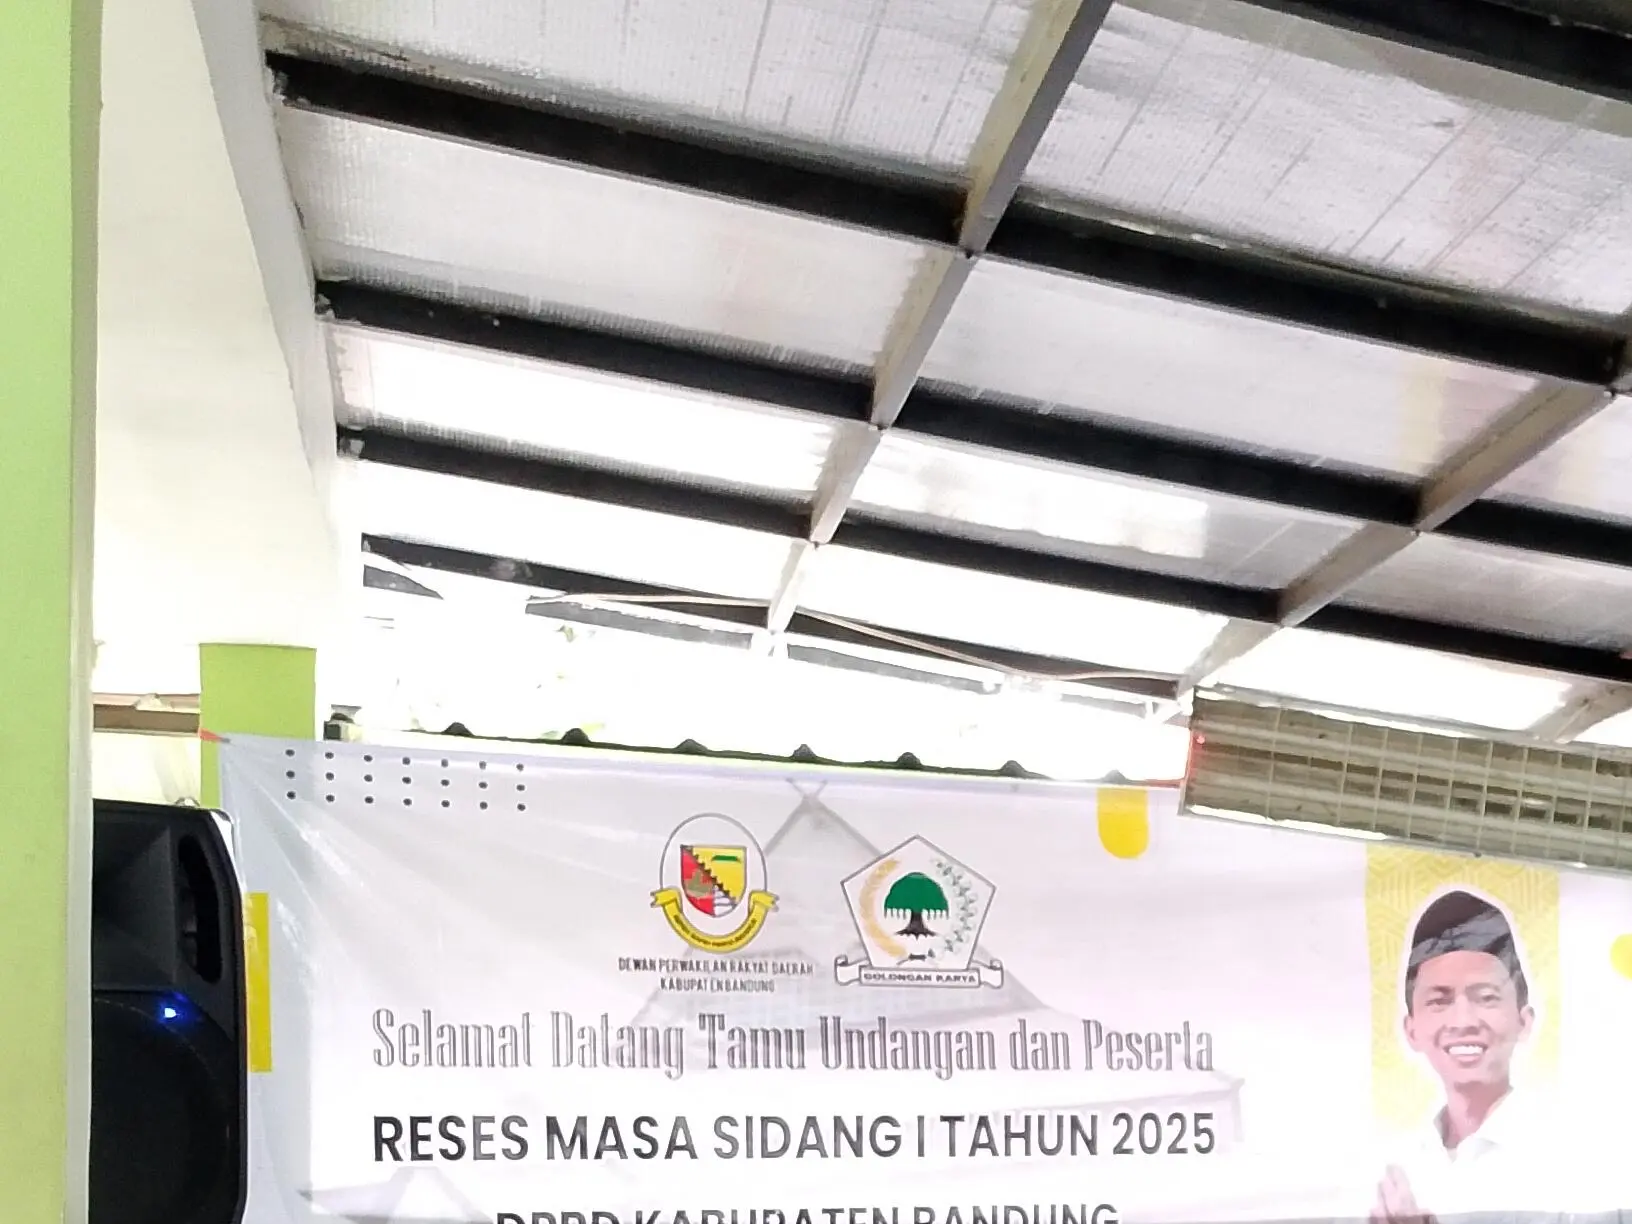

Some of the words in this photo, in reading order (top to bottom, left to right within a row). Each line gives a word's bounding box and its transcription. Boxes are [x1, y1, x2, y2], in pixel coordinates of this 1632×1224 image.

[618, 957, 656, 972] DEWAN
[658, 958, 728, 974] PERWAKILAN
[729, 959, 768, 974] RAKYAT
[772, 961, 814, 976] DAERAH
[660, 977, 724, 992] KABUPATEN
[725, 978, 775, 992] BANDUNG
[863, 973, 932, 982] GOLONGAN
[936, 975, 976, 983] KARYA
[373, 1008, 531, 1068] Selamat
[551, 1011, 686, 1081] Datang
[698, 1012, 806, 1070] Tamu
[819, 1015, 997, 1081] Undangan
[1009, 1018, 1071, 1071] dan
[1083, 1019, 1214, 1072] Peserta
[373, 1115, 529, 1162] RESES
[545, 1115, 699, 1160] MASA
[713, 1115, 901, 1159] SIDANG
[917, 1115, 925, 1158] I
[939, 1114, 1098, 1157] TAHUN
[1112, 1112, 1215, 1155] 2025
